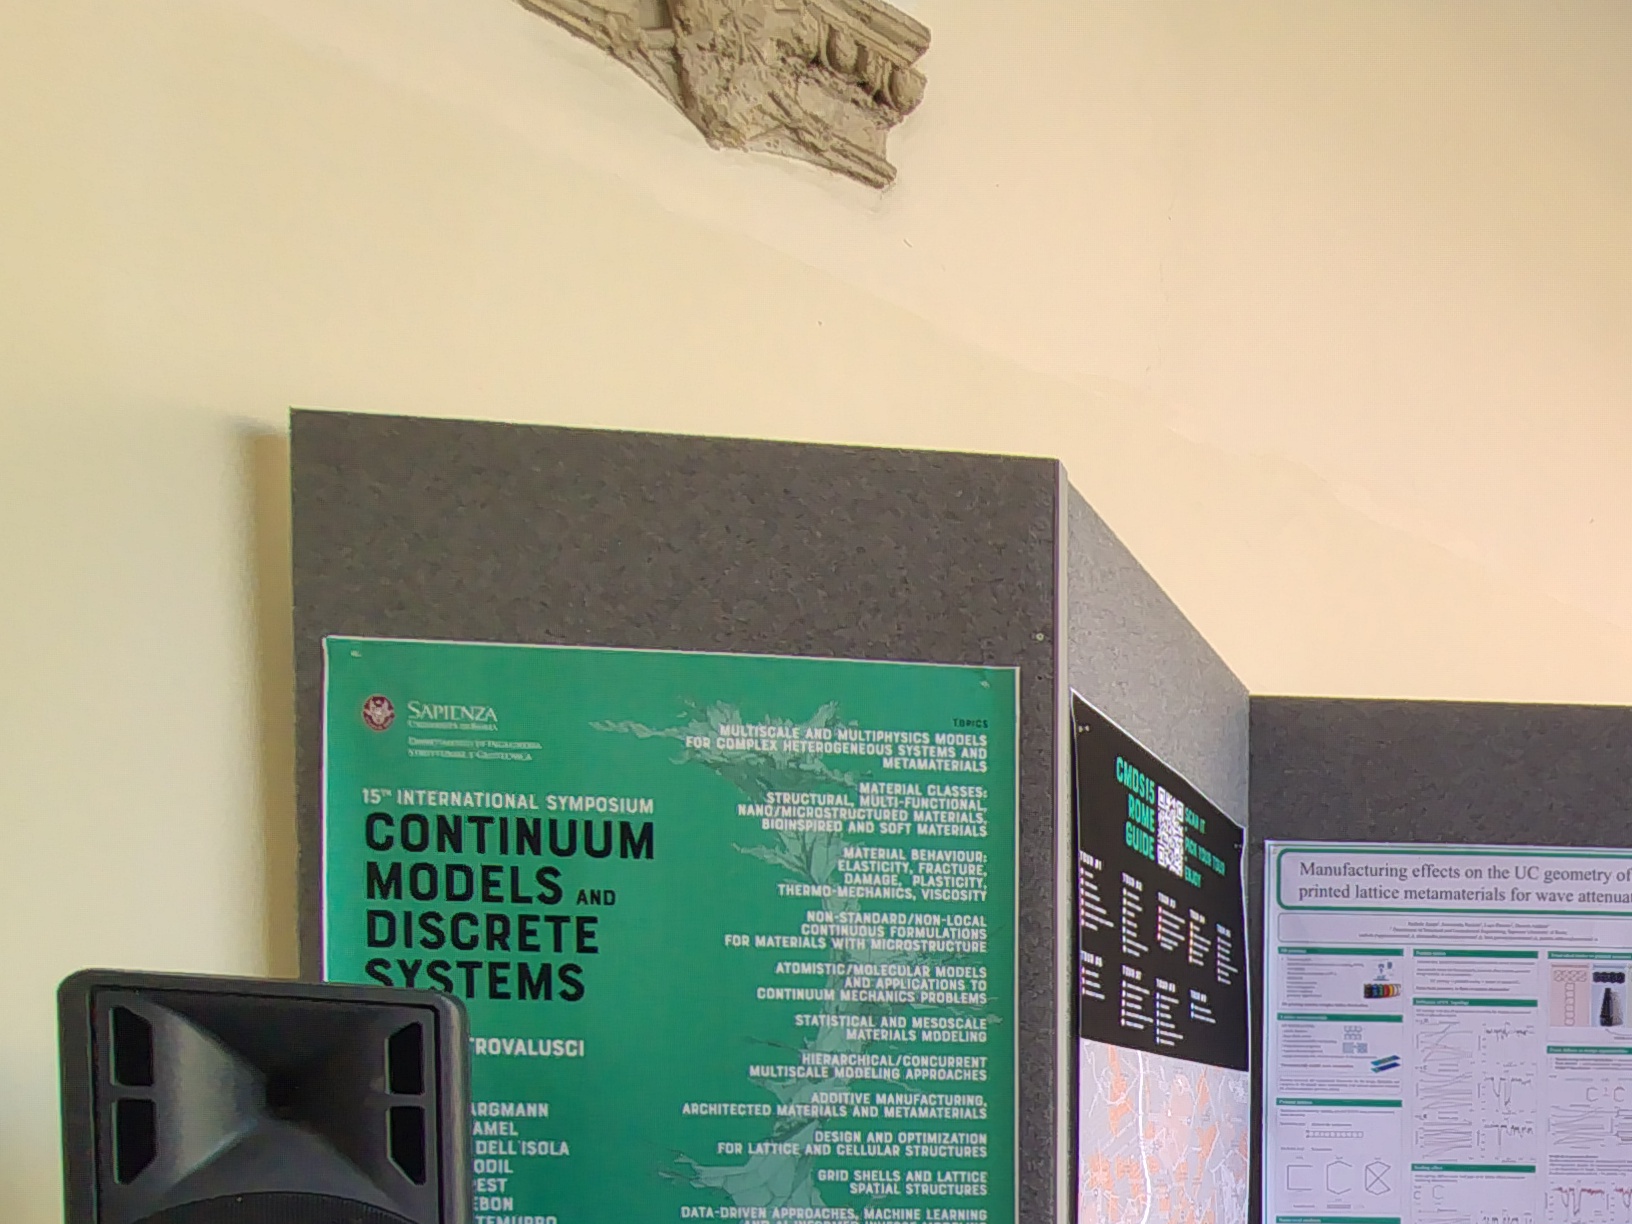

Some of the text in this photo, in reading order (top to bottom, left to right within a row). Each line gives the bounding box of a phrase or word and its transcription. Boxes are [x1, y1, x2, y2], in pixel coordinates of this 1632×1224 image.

[408, 700, 498, 722] SAPIENZA
[953, 718, 988, 728] TOPICS
[720, 724, 987, 746] MULTISCALE AND MULTIPHYSICS MODELS
[686, 737, 987, 759] FOR COMPLEX HETEROGENEOUS SYSTEMS AND
[883, 758, 987, 772] METAMATERIALS
[1116, 756, 1155, 804] CMDS15
[860, 783, 987, 798] MATERIAL CLASSES:
[397, 789, 539, 809] INTERNATIONAL
[547, 795, 654, 813] SYMPOSIUM
[766, 792, 987, 812] STRUCTURAL, MULTI-FUNCTIONAL,
[1128, 794, 1155, 833] ROME
[366, 812, 654, 859] CONTINUUM
[1126, 821, 1155, 861] GUIDE
[1300, 861, 1407, 882] Manufacturing
[1412, 863, 1460, 880] effects
[1464, 868, 1483, 880] on
[1488, 865, 1510, 880] the
[1514, 866, 1539, 881] UC
[1544, 869, 1612, 885] geometry
[366, 862, 616, 906] MODELS AND
[1299, 885, 1350, 901] printed
[1355, 885, 1399, 900] lattice
[1404, 886, 1505, 902] metamaterials
[1511, 888, 1532, 903] for
[1536, 893, 1573, 904] wave
[807, 911, 987, 927] NON-STANDARD/NON-LOCAL
[367, 909, 598, 954] DISCRETE
[801, 924, 986, 940] CONTINUOUS FORMULATIONS
[365, 958, 585, 1002] SYSTEMS
[802, 1053, 987, 1067] HIERARCHICAL/CONCURRENT
[749, 1065, 987, 1081] MULTISCALE MODELING APPROACHES
[476, 1140, 569, 1155] DELL'ISOLA
[472, 1178, 507, 1192] EST
[818, 1169, 987, 1183] GRID SHELLS AND LATTICE
[850, 1183, 987, 1196] SPATIAL STRUCTURES
